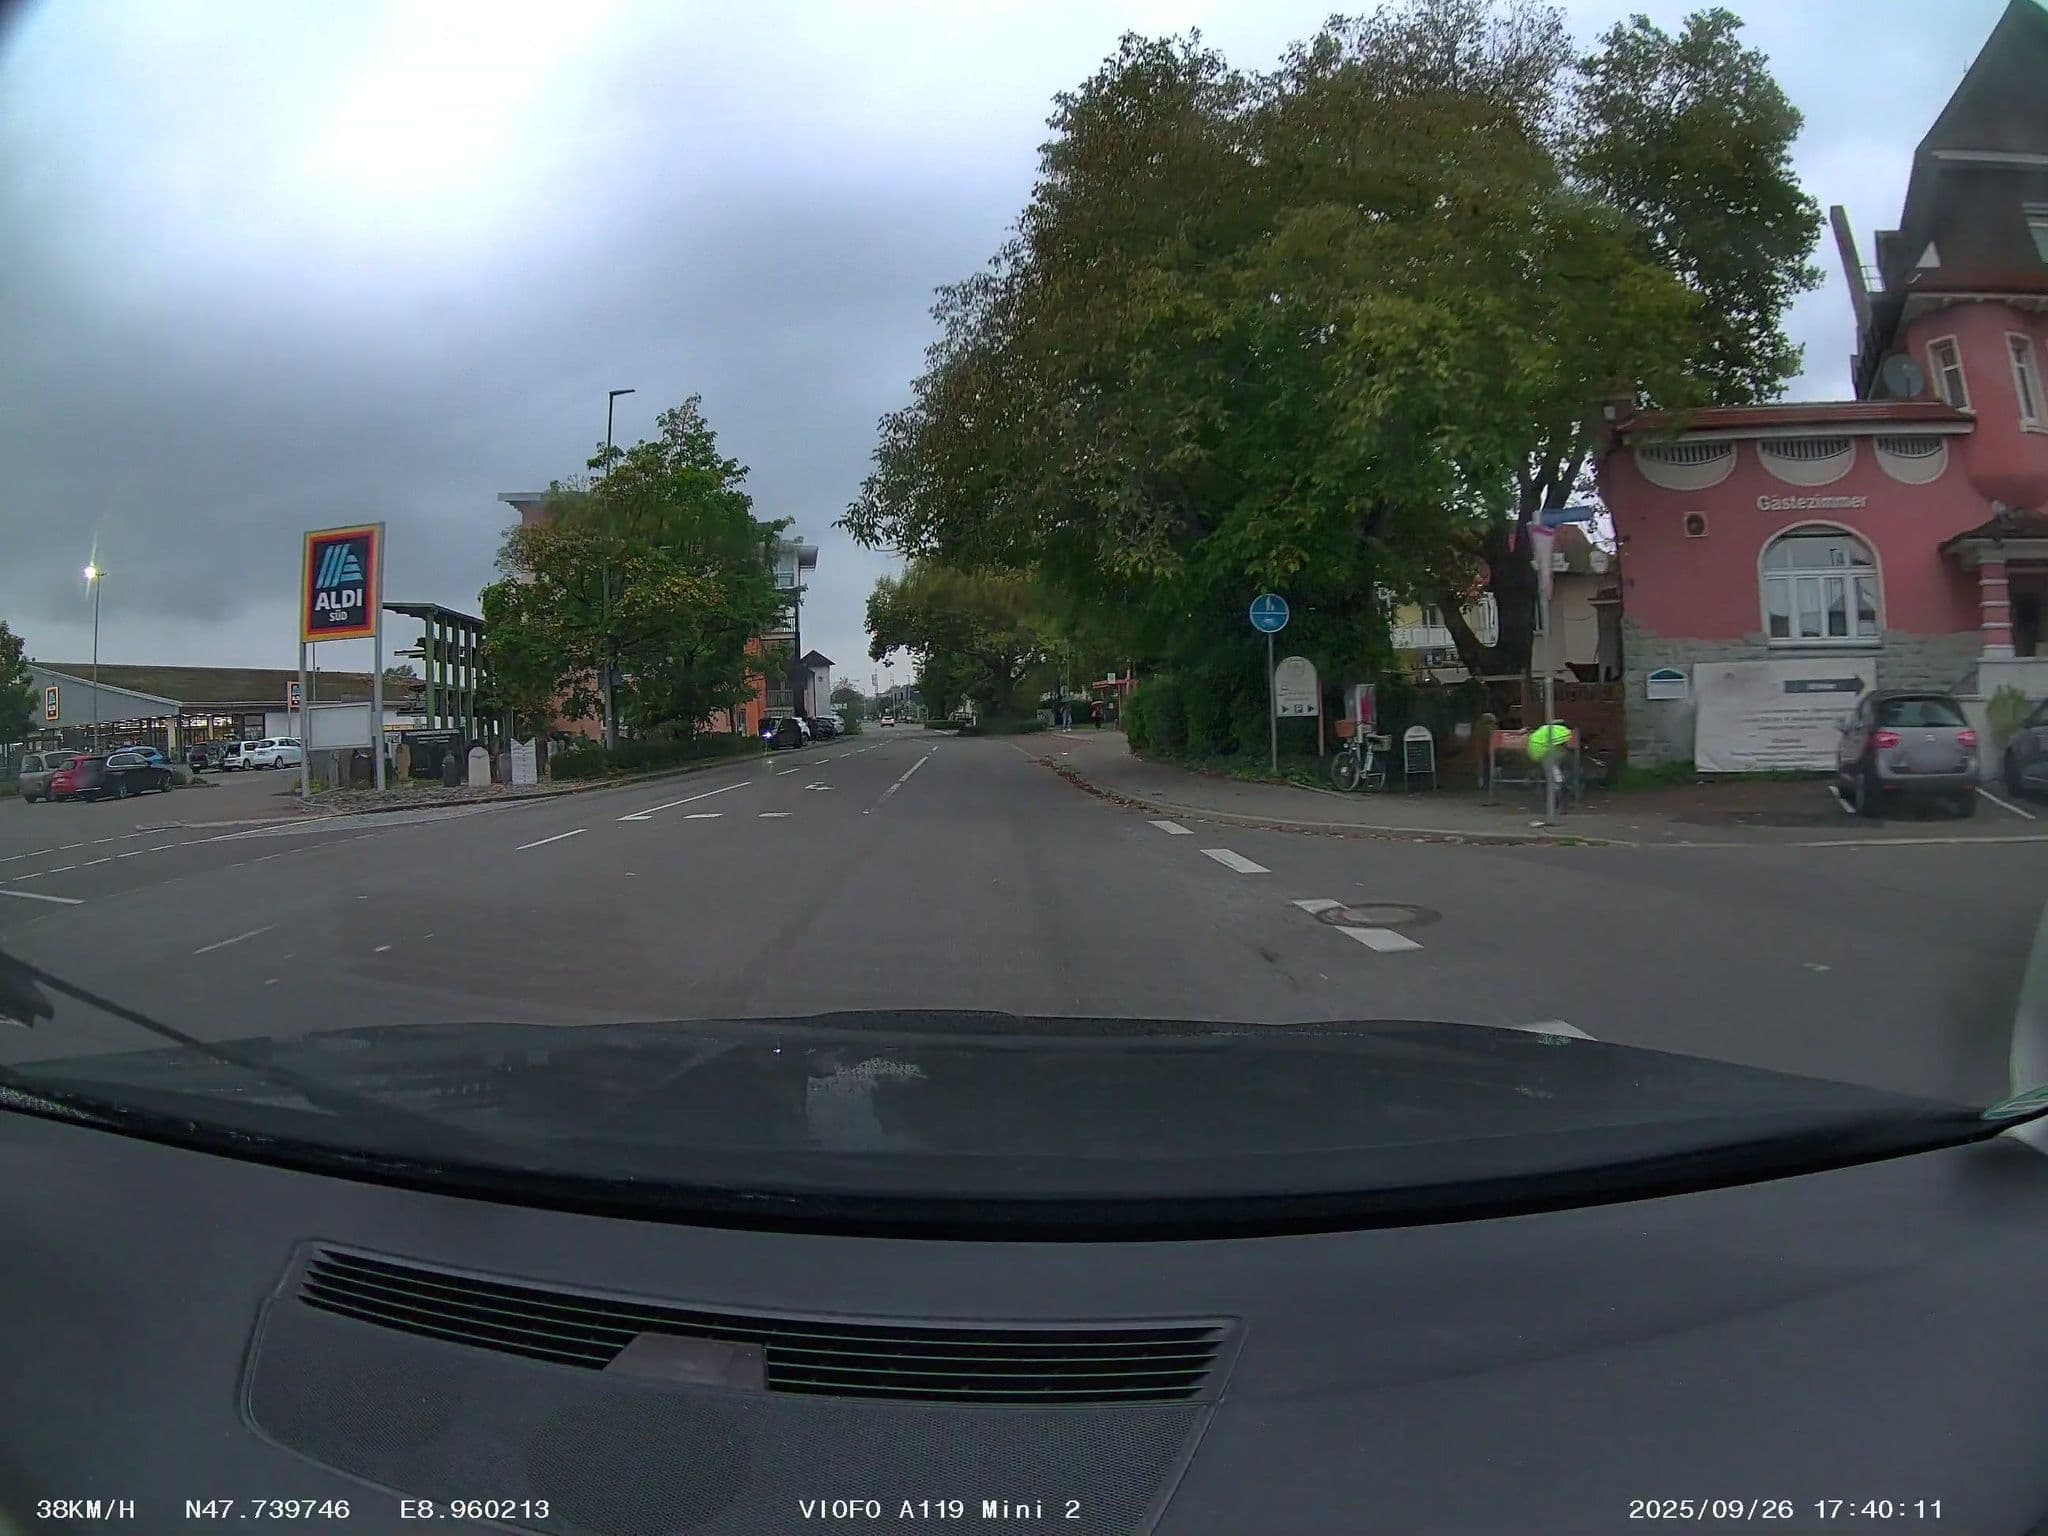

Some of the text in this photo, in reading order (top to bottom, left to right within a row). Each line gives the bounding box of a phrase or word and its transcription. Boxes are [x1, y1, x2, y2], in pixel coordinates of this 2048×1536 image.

[1756, 495, 1868, 511] Gästezimmer
[315, 589, 363, 611] ALDI
[329, 609, 348, 622] SÜD
